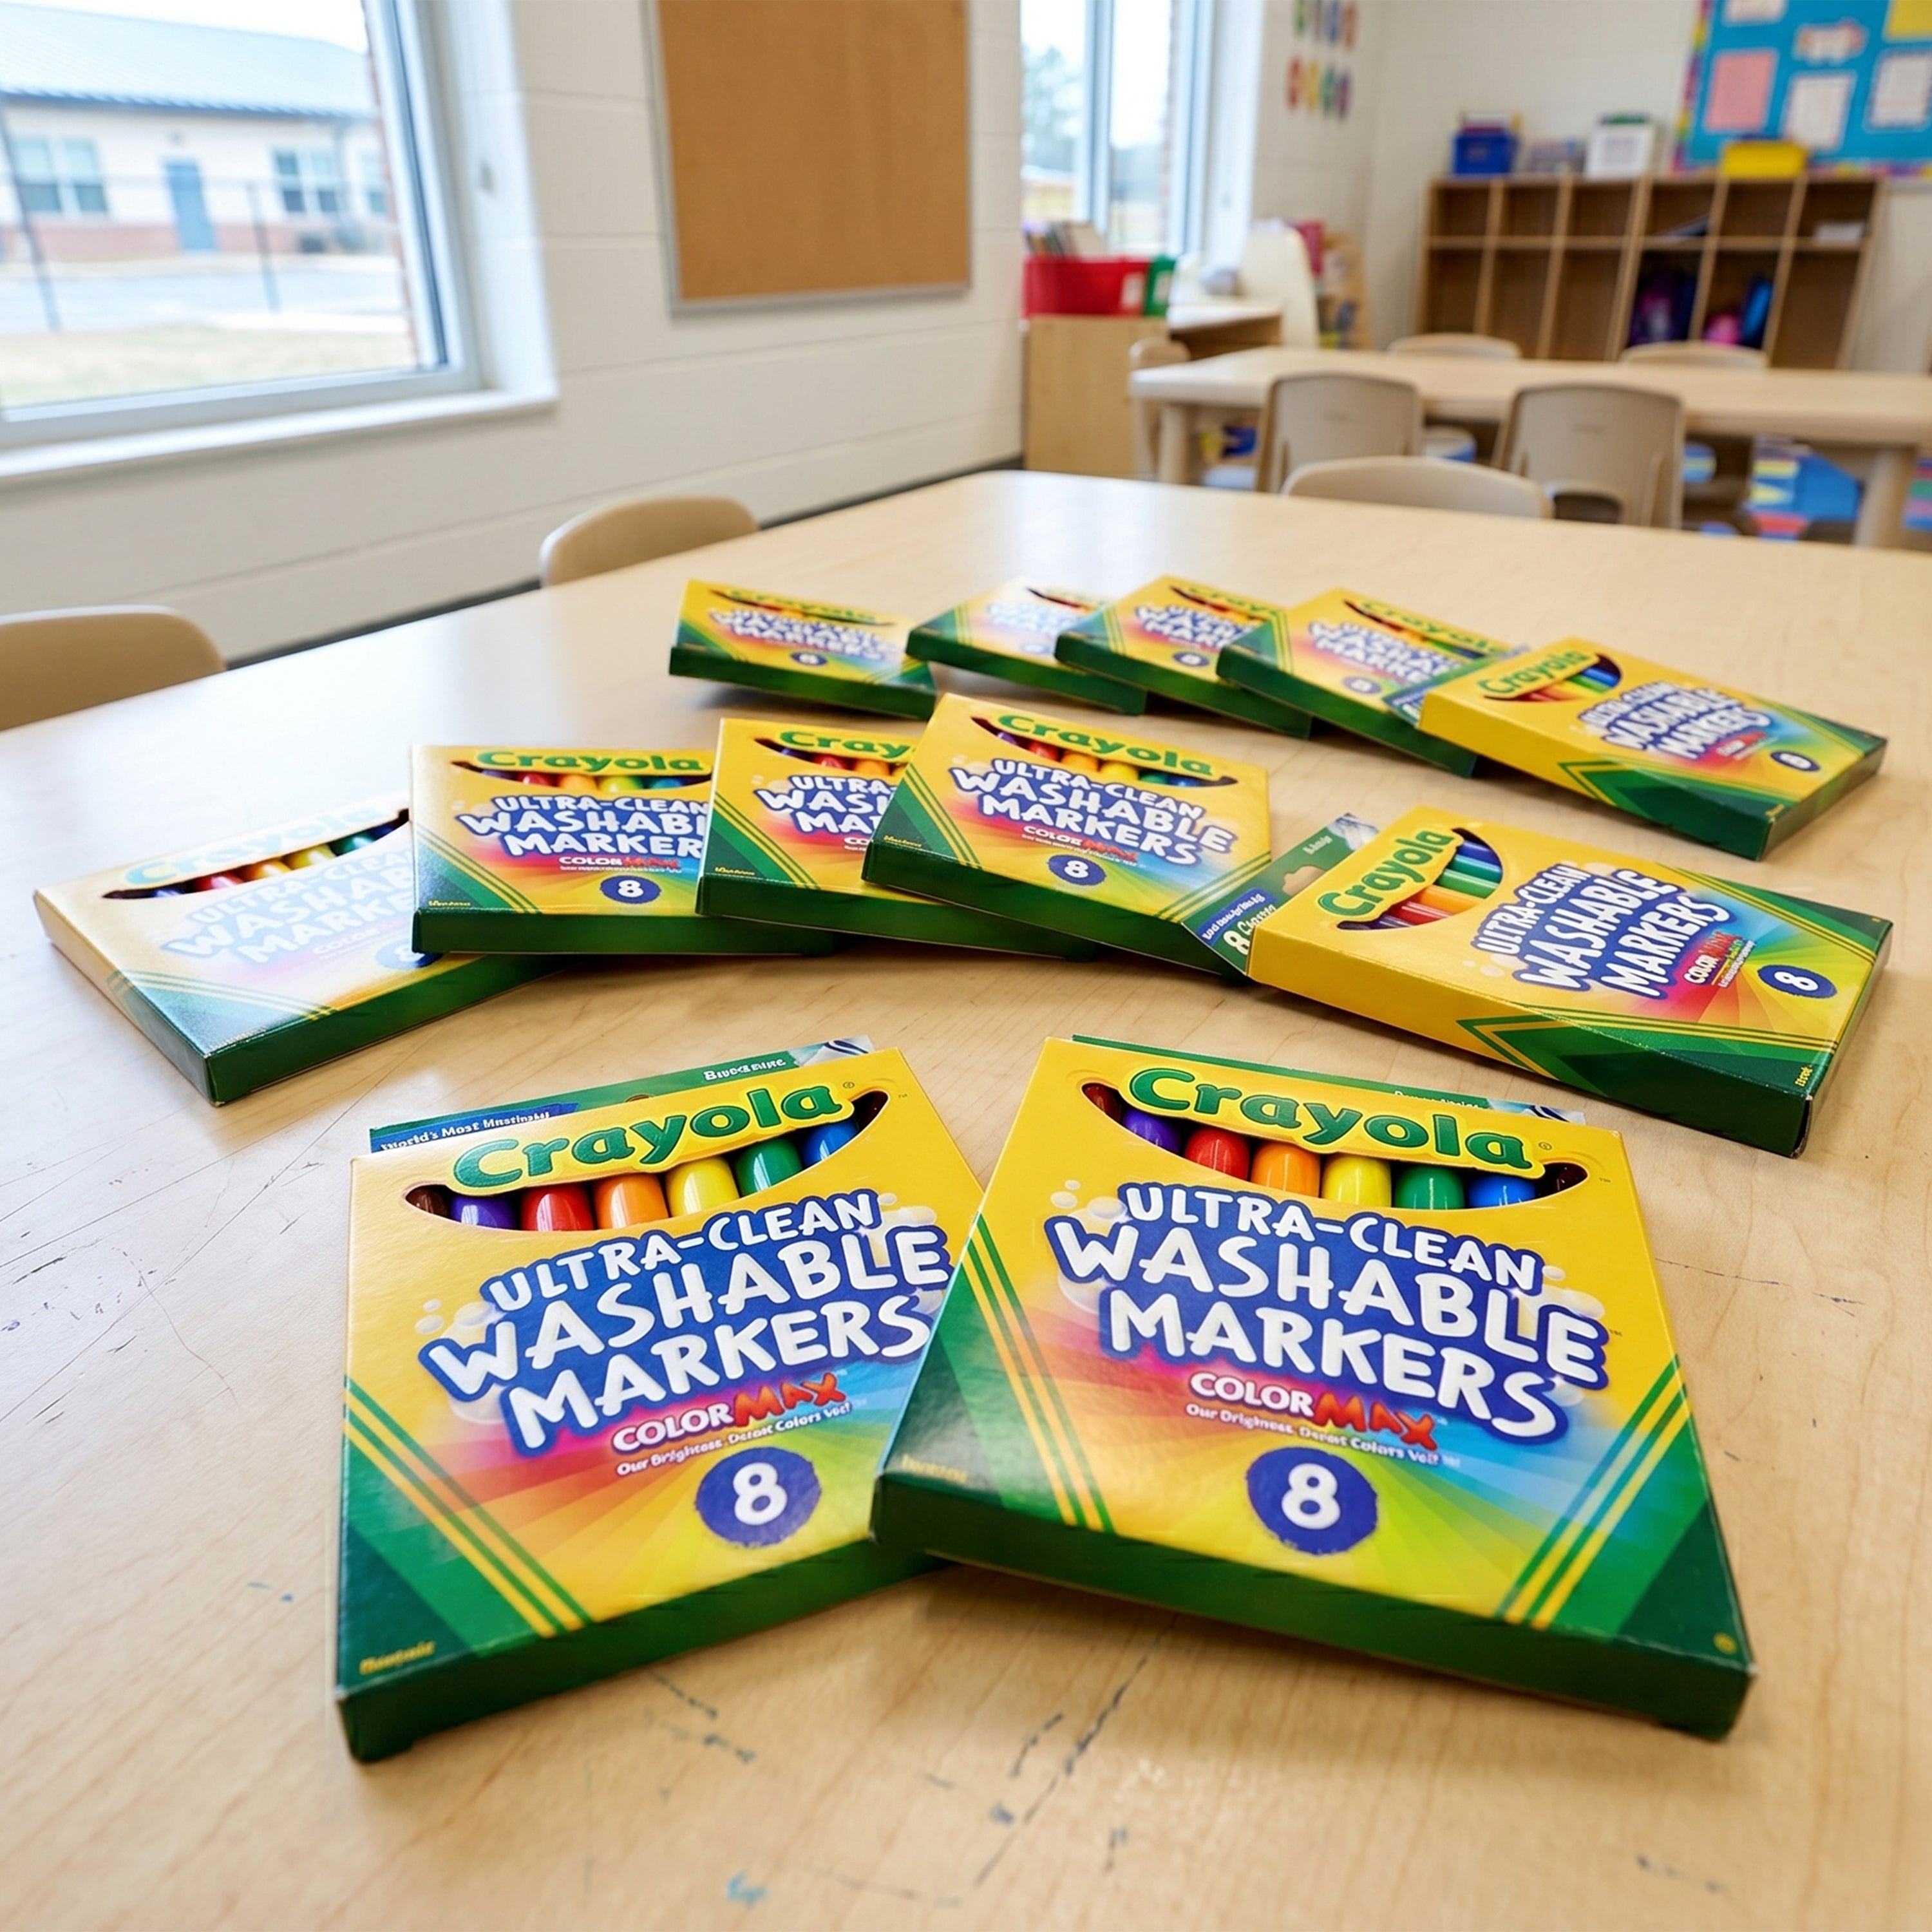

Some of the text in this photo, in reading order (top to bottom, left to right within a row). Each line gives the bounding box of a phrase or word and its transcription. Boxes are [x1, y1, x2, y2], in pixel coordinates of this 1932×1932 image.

[1478, 651, 1592, 694] Crayola
[477, 751, 703, 772] Crayola
[780, 732, 915, 759] Cray
[998, 714, 1213, 775] Crayola
[495, 796, 708, 815] ULTRA-CLEAN
[952, 768, 1234, 853] WASHABLE
[994, 759, 1205, 819] ULTRA-CLEAN
[503, 832, 703, 859] MARKER
[981, 794, 1198, 866] MARKERS
[195, 849, 413, 923] ULTRA-CLEA
[618, 880, 643, 898] 8
[1064, 860, 1088, 878] 8
[1318, 830, 1456, 916] Crayola
[1478, 866, 1591, 954] ULTRA-CLEAN
[1520, 870, 1678, 990] WASHABLE
[1600, 895, 1730, 998] MARKERS
[1774, 971, 1818, 992] 8
[453, 1084, 842, 1188] Crayola
[1129, 1067, 1533, 1169] Crayola
[489, 1193, 878, 1312] ULTRA-CLEAN
[1127, 1186, 1536, 1291] ULTRA-CLEAN
[428, 1229, 949, 1394] WASHABLE
[1055, 1222, 1598, 1382] WASHABLE
[507, 1294, 931, 1450] MARKERS
[1110, 1290, 1557, 1437] MARKERS
[612, 1372, 847, 1452] COLORMAX
[775, 1412, 822, 1432] Colors
[1191, 1372, 1438, 1451] COLORMAX
[733, 1462, 788, 1526] 8
[1281, 1463, 1341, 1530] 8
